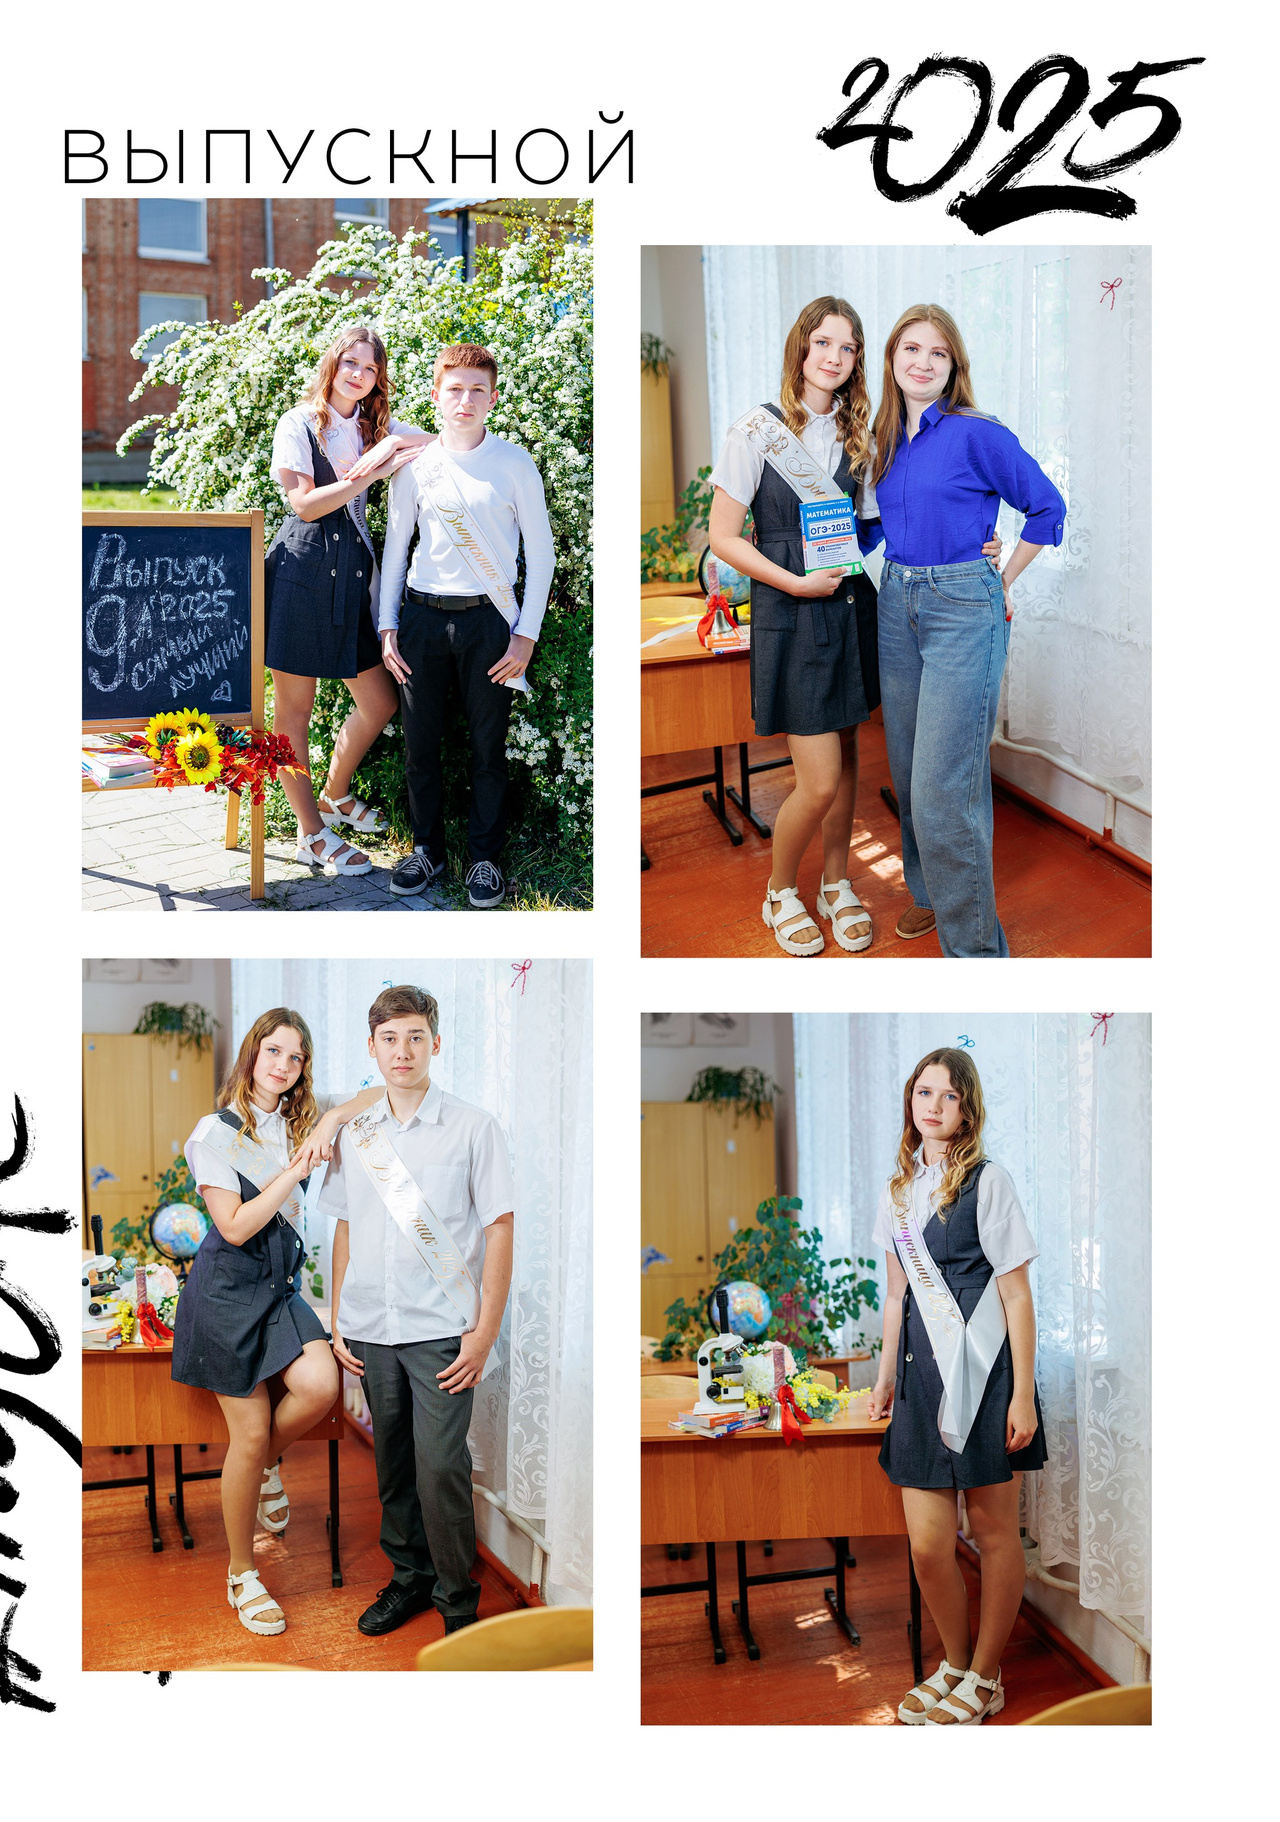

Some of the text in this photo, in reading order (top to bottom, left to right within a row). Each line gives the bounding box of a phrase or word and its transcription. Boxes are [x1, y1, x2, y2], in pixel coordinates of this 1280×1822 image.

[806, 506, 852, 519] МАТЕМАТИКА
[810, 522, 852, 536] ОГЭ-2025
[817, 545, 826, 553] 40
[89, 533, 227, 591] Выпуск
